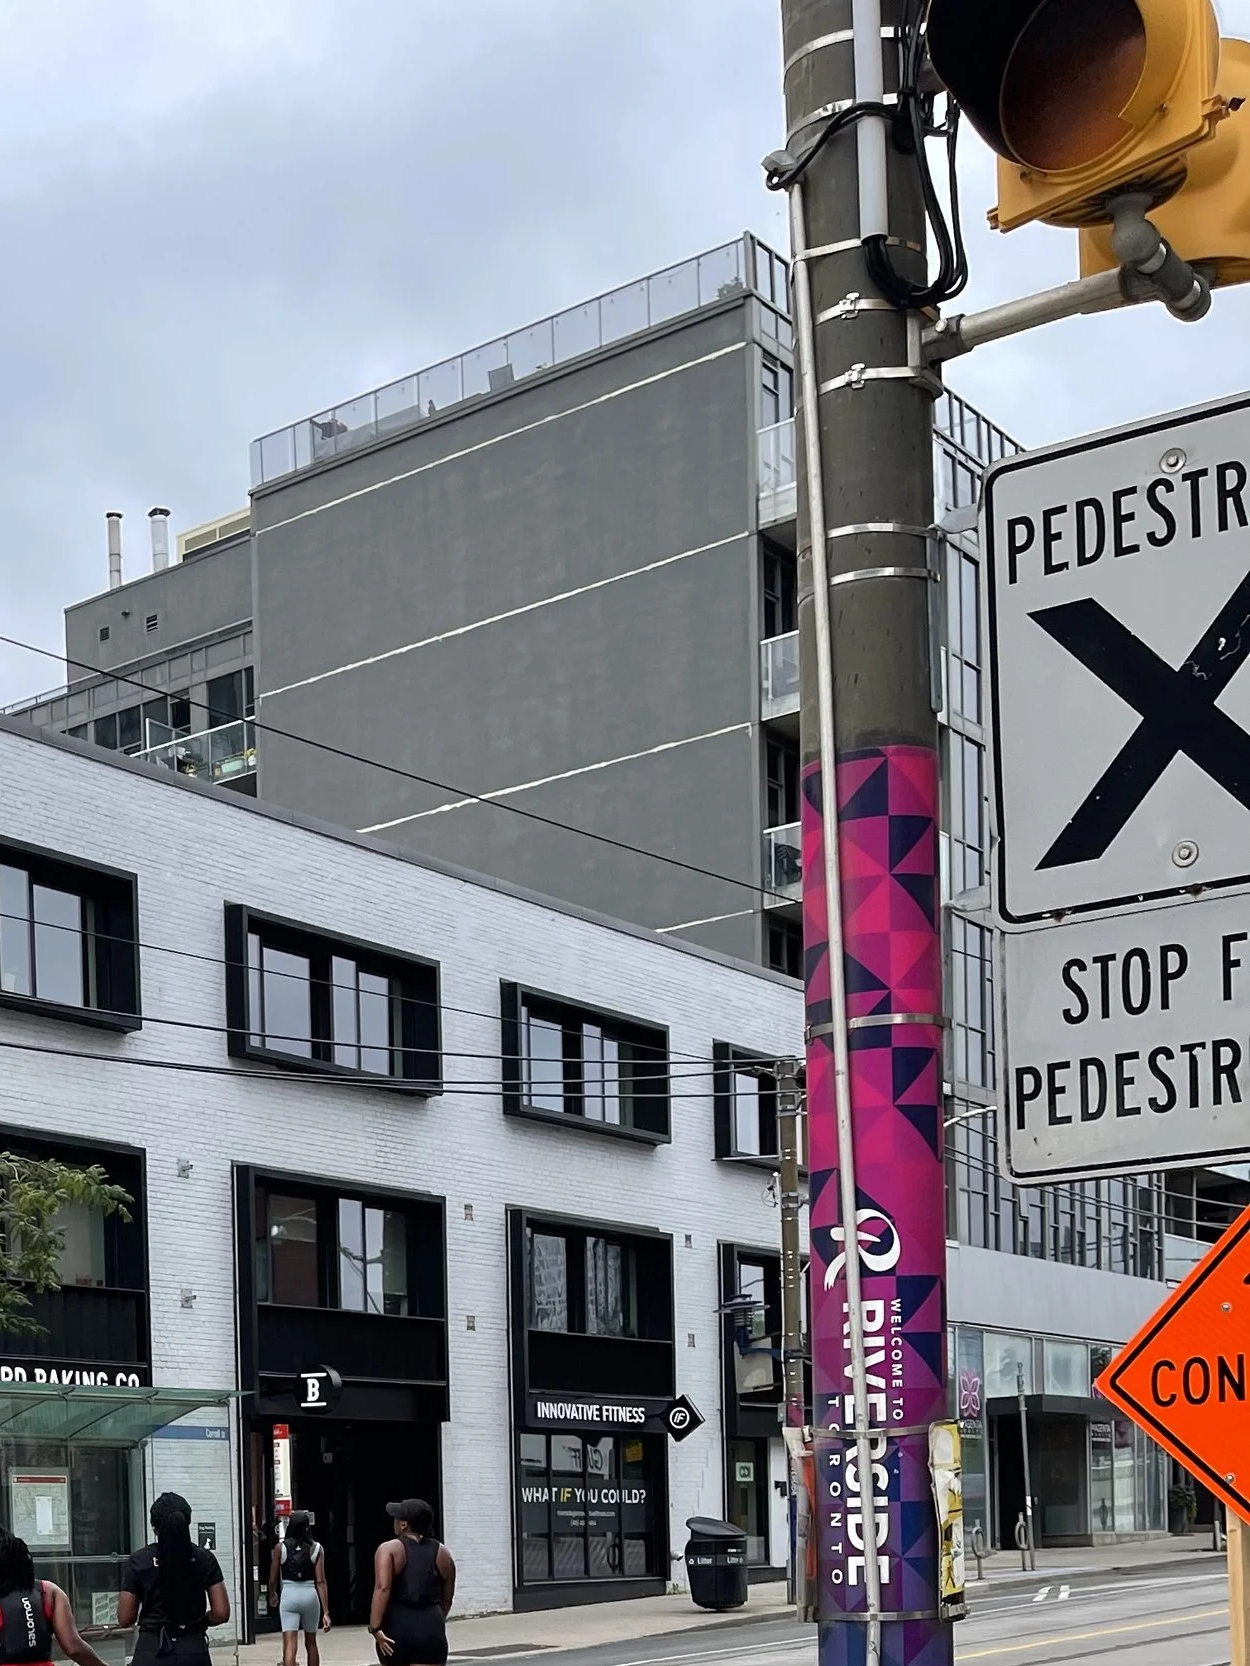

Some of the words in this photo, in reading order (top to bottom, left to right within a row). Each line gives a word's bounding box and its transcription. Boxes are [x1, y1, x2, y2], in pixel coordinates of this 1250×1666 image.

[1061, 943, 1188, 1025] STOP
[1015, 1038, 1250, 1130] PEDESTR
[890, 1298, 903, 1388] WELCOME
[537, 1401, 600, 1421] INNOVATIVE
[602, 1406, 645, 1424] FITNESS
[843, 1299, 890, 1586] RIVERSIDE
[892, 1398, 904, 1421] TO
[521, 1487, 558, 1503] WHAT
[560, 1488, 572, 1503] IF
[574, 1488, 598, 1503] YOU
[601, 1489, 646, 1504] COULD?
[21, 1597, 37, 1648] salomon
